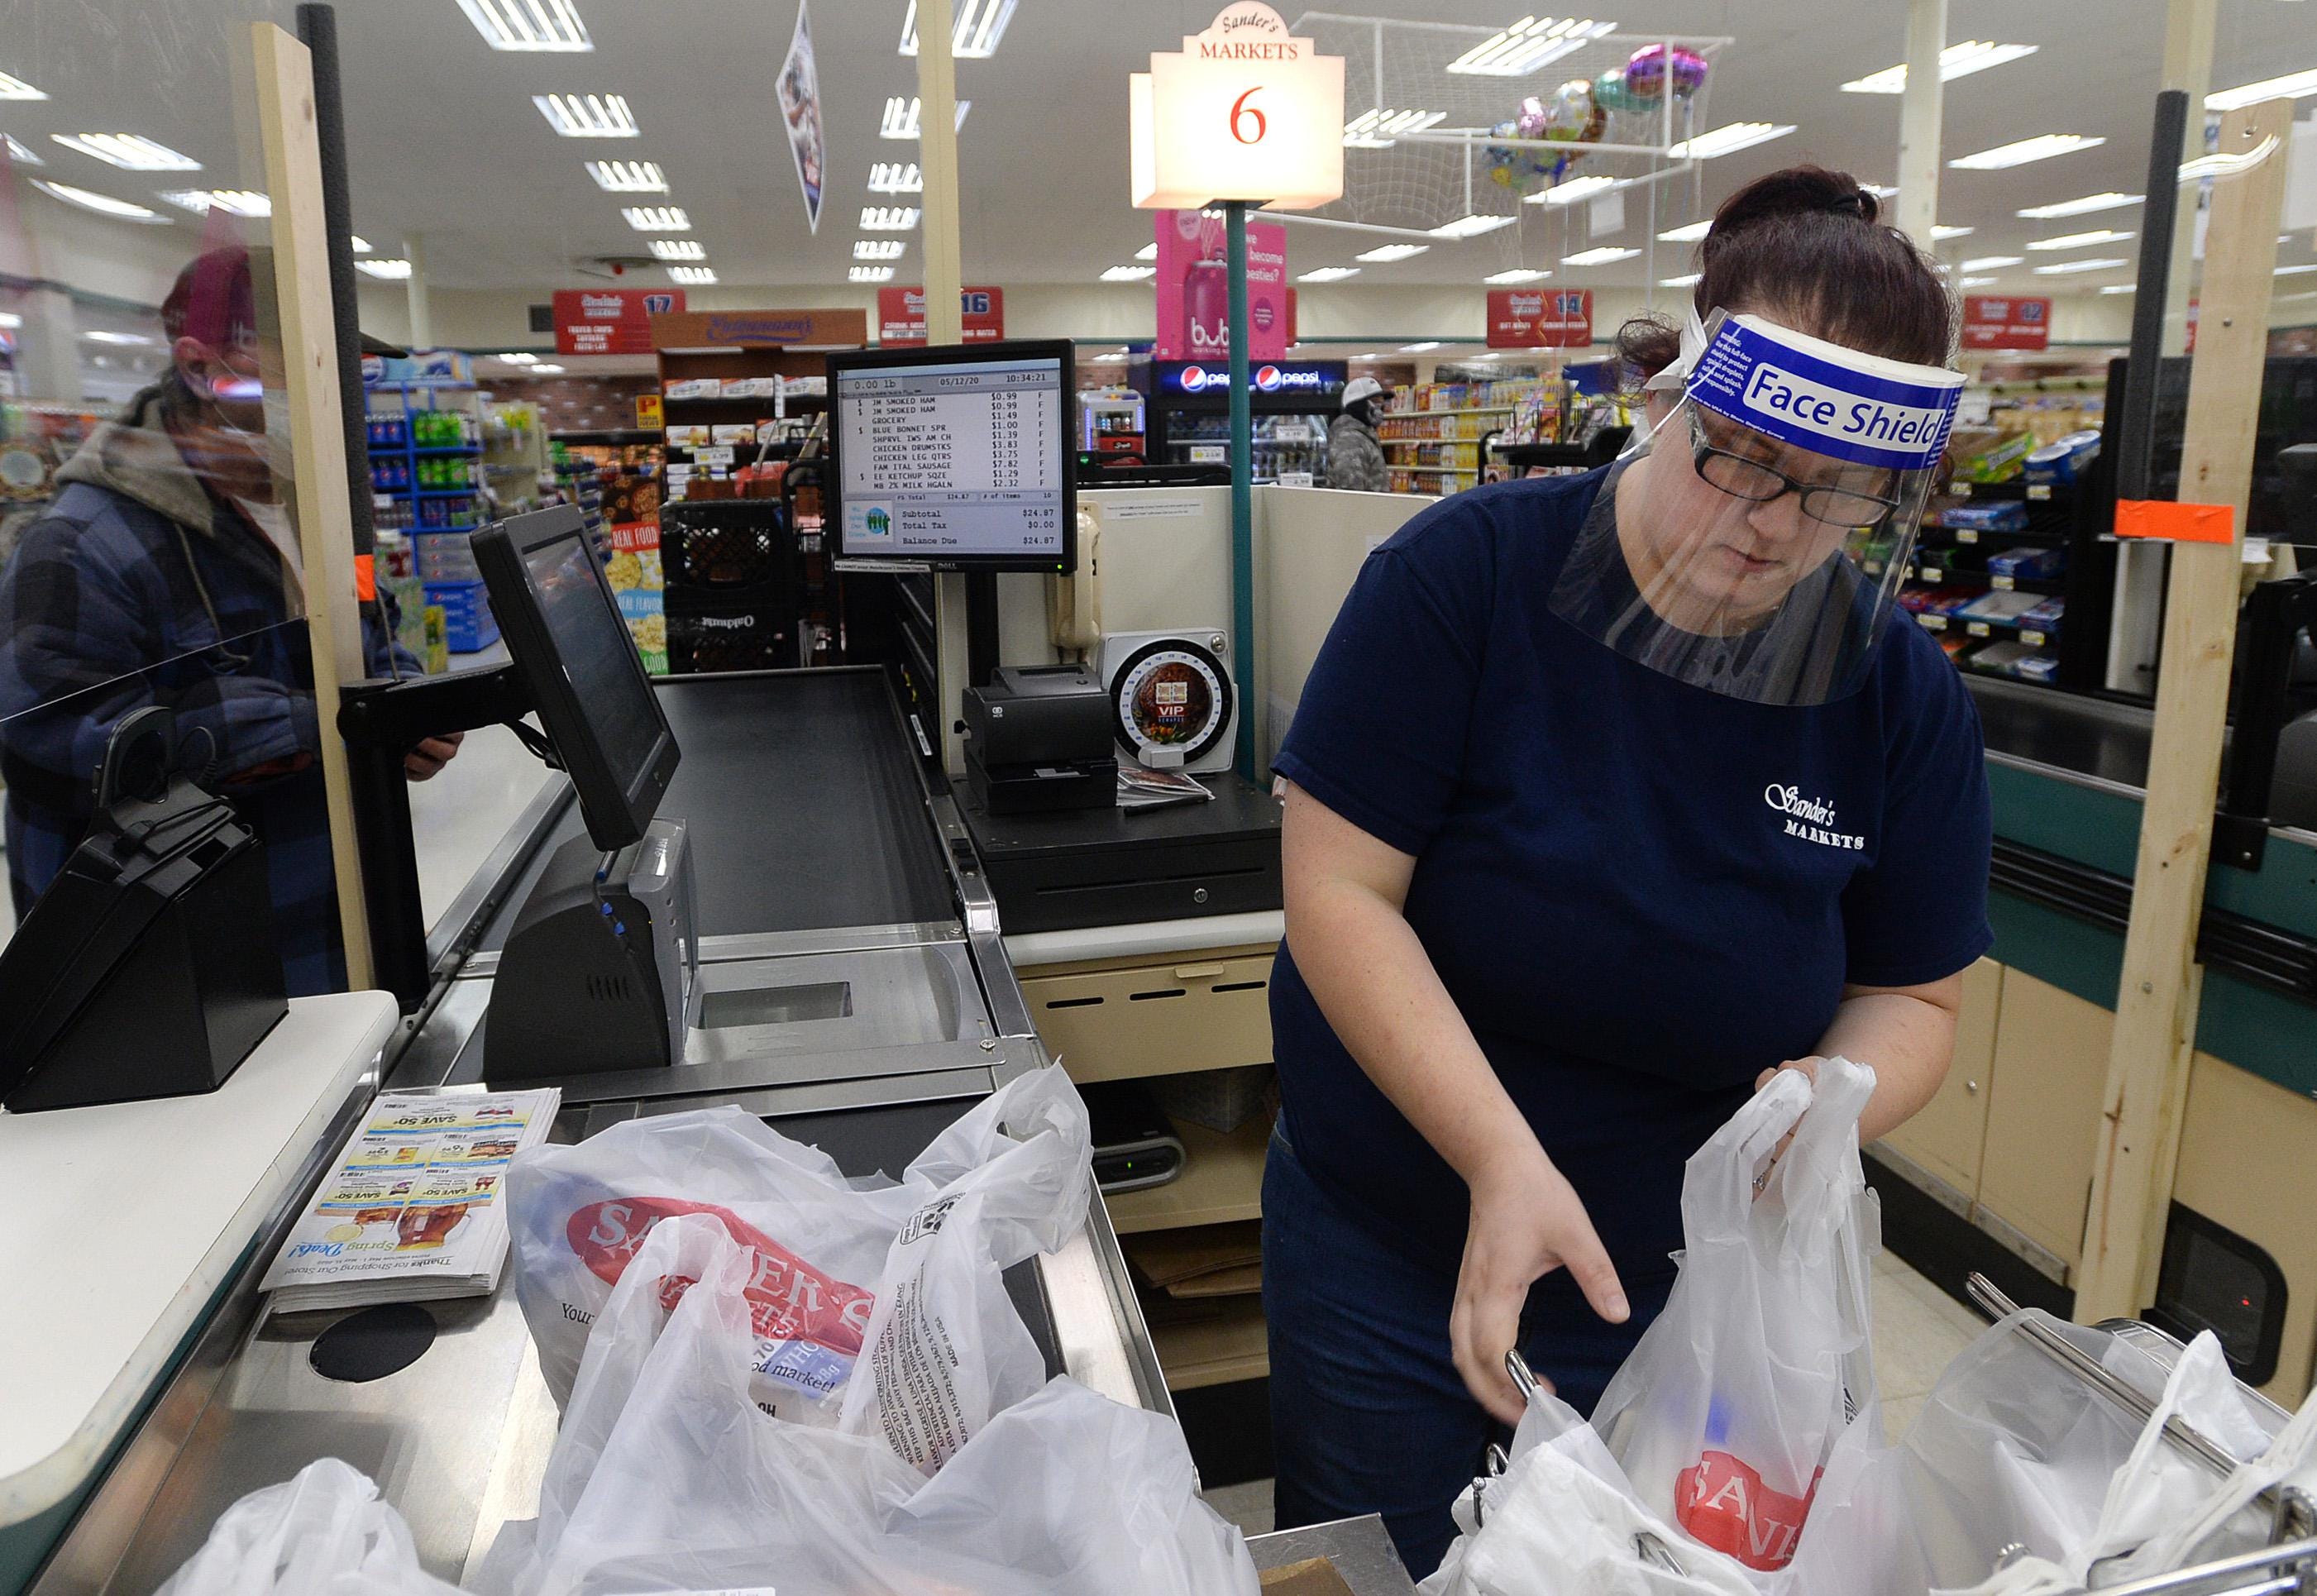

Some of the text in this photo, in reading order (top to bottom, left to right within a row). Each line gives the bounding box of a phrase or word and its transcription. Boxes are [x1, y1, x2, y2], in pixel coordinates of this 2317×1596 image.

[1223, 12, 1278, 33] Sander's
[1200, 43, 1298, 60] MARKETS
[1230, 86, 1266, 144] 6
[1249, 247, 1283, 264] become
[961, 293, 990, 314] 16
[855, 380, 896, 389] 0.00 lb
[940, 377, 979, 385] 05/12/20
[1006, 374, 1045, 382] 10:34:21
[1282, 371, 1319, 386] pepsi
[991, 393, 1017, 401] $0.99
[991, 402, 1017, 410] $0.99
[1751, 369, 1836, 425] Face
[1842, 404, 1943, 444] Shield
[992, 412, 1017, 420] $1.49
[992, 431, 1018, 439] $1.39
[992, 441, 1018, 449] $3.83
[993, 460, 1018, 468] $7.82
[993, 470, 1018, 478] $1.29
[1023, 509, 1053, 518] $24.87
[1028, 521, 1054, 529] $0.00
[613, 527, 657, 547] REAL FOOD
[1023, 537, 1054, 545] $24.87
[1159, 706, 1184, 715] VIP
[1765, 784, 1836, 826] Sander's
[1784, 820, 1864, 849] MARKETS
[420, 1116, 457, 1124] SAVE
[288, 1242, 395, 1258] Spring Deals!
[341, 1262, 390, 1272] Shopping
[411, 1258, 451, 1267] Thanks
[934, 1316, 944, 1332] USA
[562, 1302, 595, 1324] Your
[772, 1364, 836, 1393] market!
[945, 1343, 958, 1366] MADE
[907, 1382, 917, 1398] UNA
[916, 1374, 926, 1393] PARA
[925, 1373, 940, 1403] ALEJADA
[894, 1388, 905, 1408] AWAY
[891, 1411, 899, 1422] TO
[901, 1409, 911, 1426] BAG
[917, 1407, 931, 1438] REGRESE
[924, 1394, 944, 1447] ADVERTENCIA:
[938, 1405, 948, 1428] BOLSA
[882, 1420, 891, 1431] TO
[896, 1422, 914, 1464] WARNING:
[908, 1427, 917, 1444] THIS
[914, 1445, 924, 1462] KEEP
